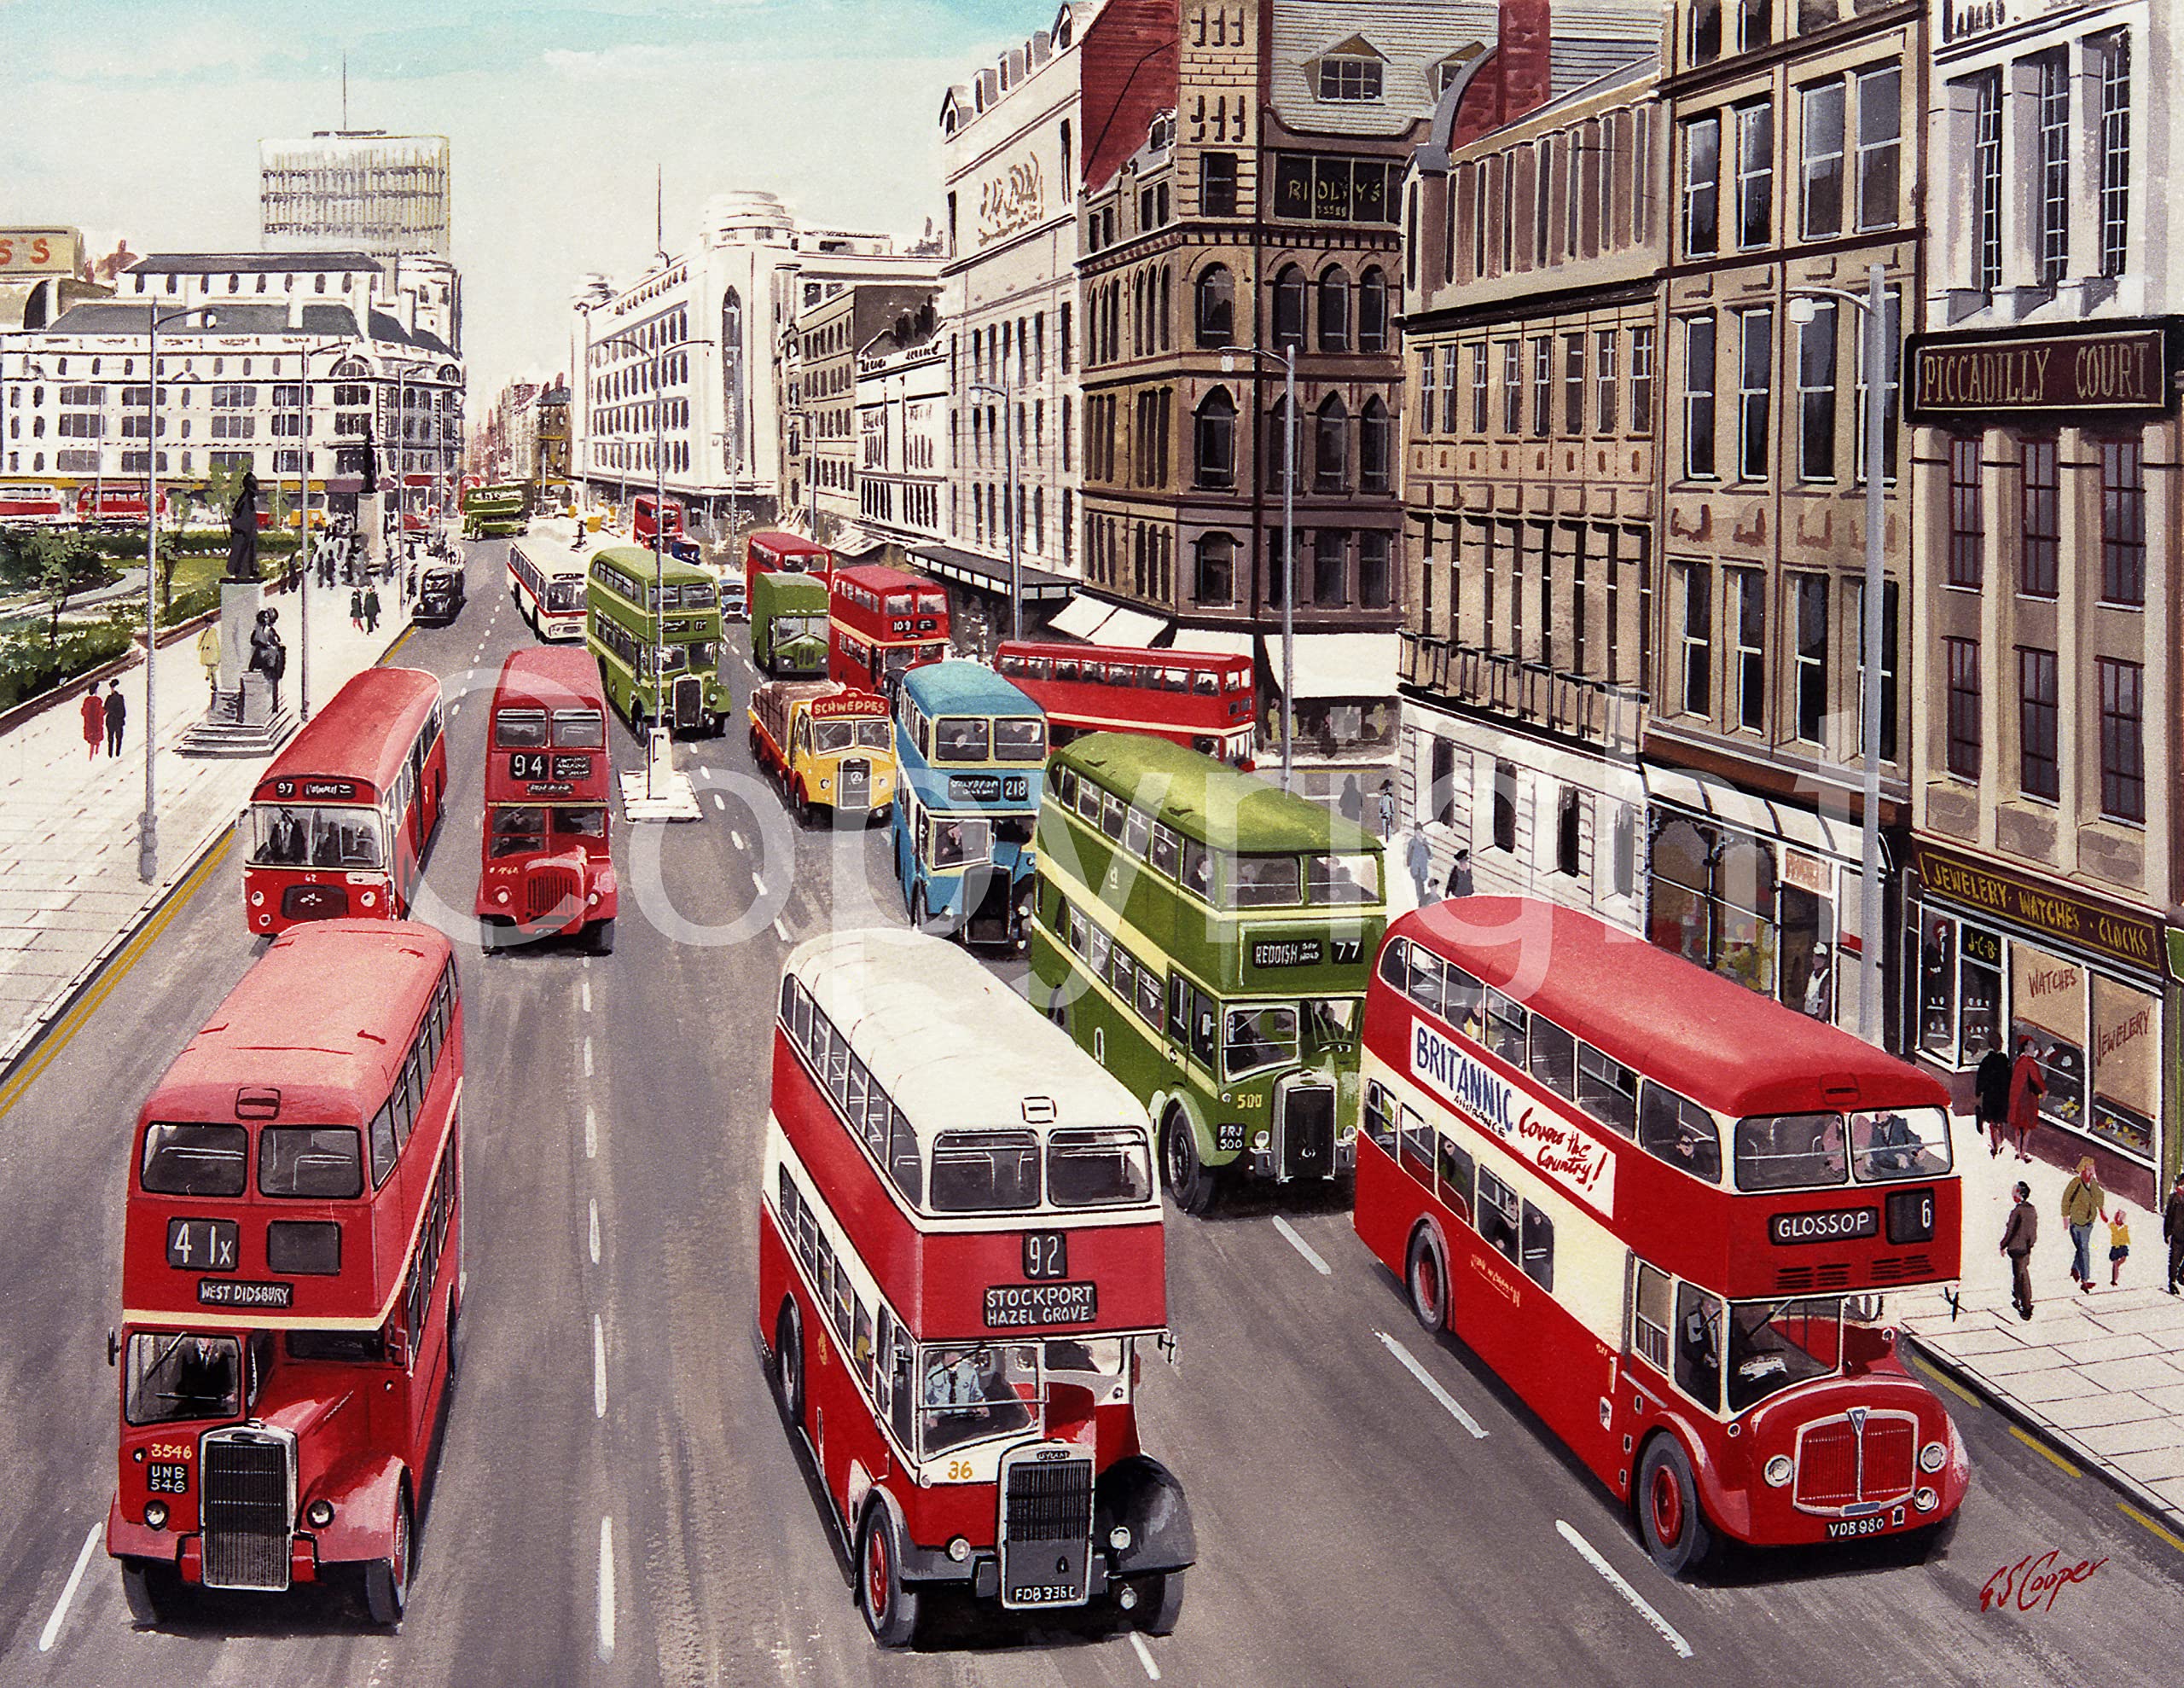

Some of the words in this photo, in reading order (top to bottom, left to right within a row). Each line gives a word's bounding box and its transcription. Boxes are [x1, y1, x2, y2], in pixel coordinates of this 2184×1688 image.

[1923, 347, 2051, 404] PICCADILLY
[2075, 341, 2149, 399] COURT
[814, 700, 886, 715] SCHWEPPES
[514, 754, 543, 778] 94
[278, 783, 293, 794] 97
[1005, 780, 1025, 797] 218
[2018, 890, 2080, 931] WATCHES
[2099, 916, 2148, 956] CLOCKS
[1256, 943, 1298, 964] REDDISH
[1336, 941, 1360, 960] 77
[2028, 967, 2077, 998] WATCHES
[2095, 1005, 2152, 1067] JEWELERY
[1416, 1026, 1513, 1133] BRITANNIC
[1237, 1093, 1263, 1109] 500
[1220, 1127, 1243, 1137] FRJ
[1219, 1137, 1243, 1150] 500
[1921, 1199, 1932, 1228] 6
[1778, 1211, 1870, 1238] GLOSSOP
[1029, 1236, 1060, 1275] 92
[201, 1284, 231, 1301] WEST
[234, 1285, 290, 1304] DIDSBURY
[986, 1285, 1094, 1308] STOCKPORT
[987, 1307, 1037, 1326] HAZEL
[1043, 1305, 1089, 1323] GROVE
[151, 1443, 193, 1459] 3546
[947, 1461, 973, 1480] 36
[150, 1479, 186, 1493] 546
